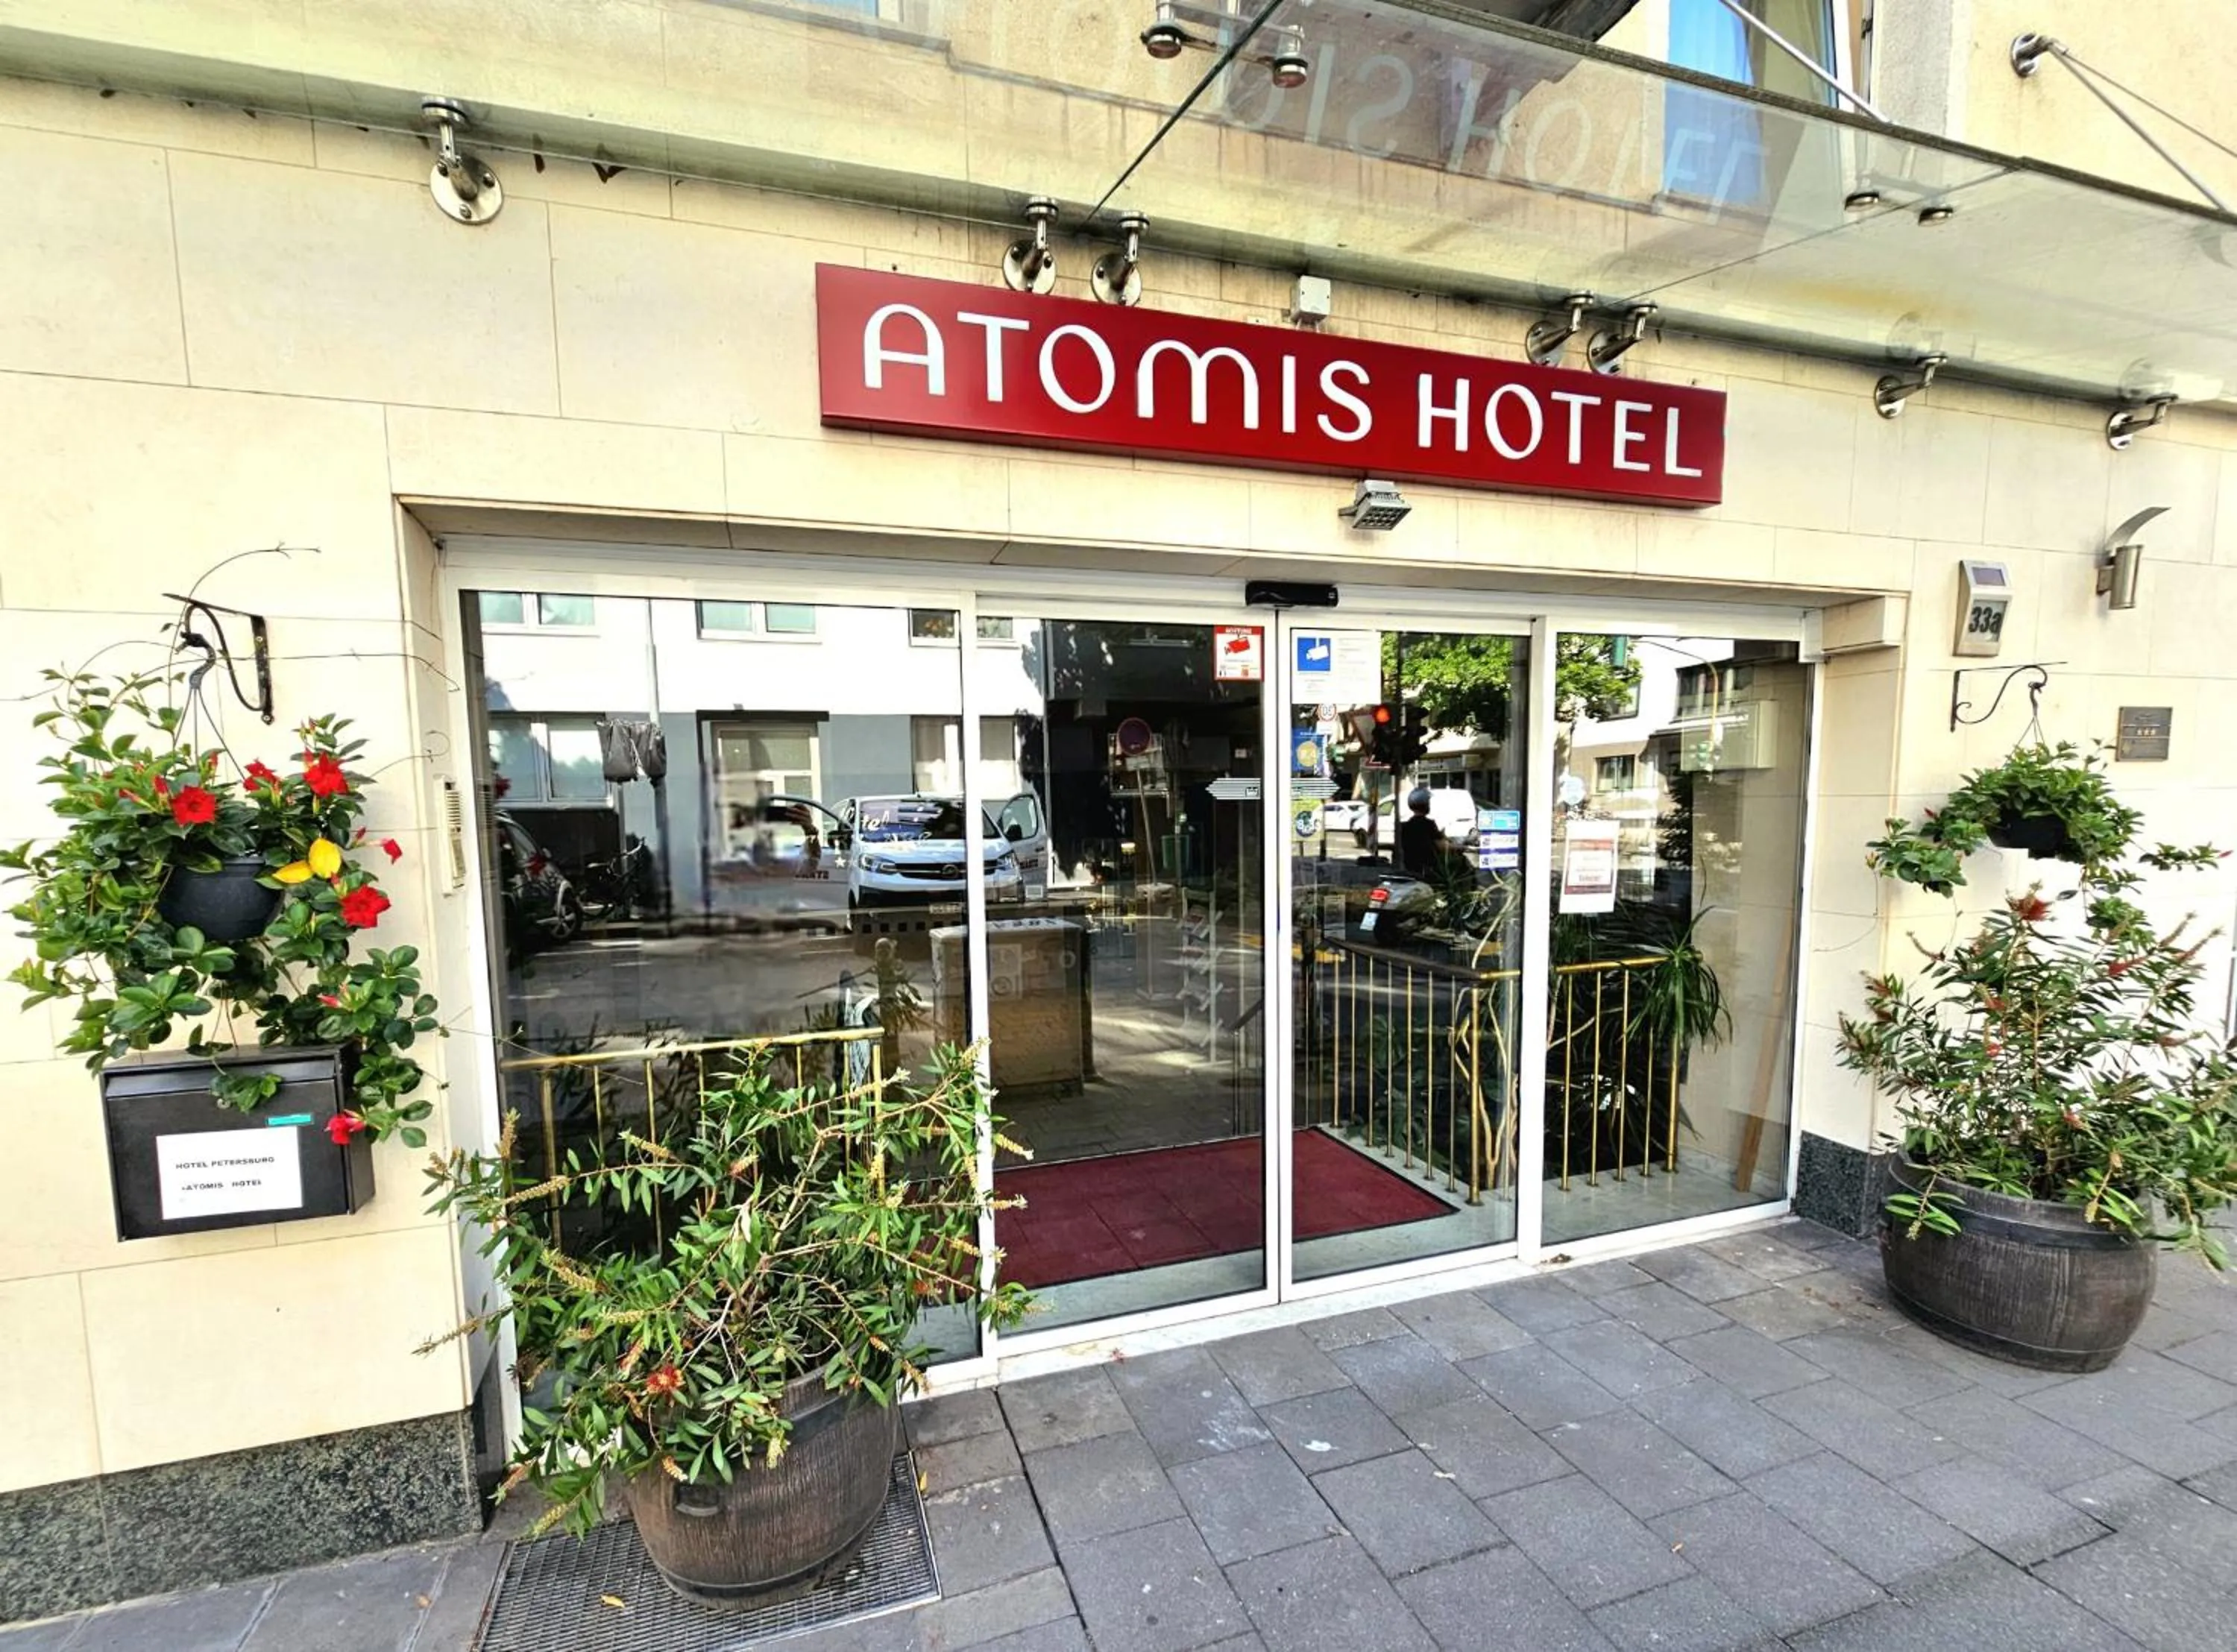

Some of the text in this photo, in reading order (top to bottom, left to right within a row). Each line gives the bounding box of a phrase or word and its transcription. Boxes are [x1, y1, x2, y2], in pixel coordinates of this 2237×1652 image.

[863, 303, 1702, 478] ATOMIS HOTEL
[176, 1156, 275, 1170] HOTEL PETERSBURG
[232, 1179, 262, 1187] HOTEL
